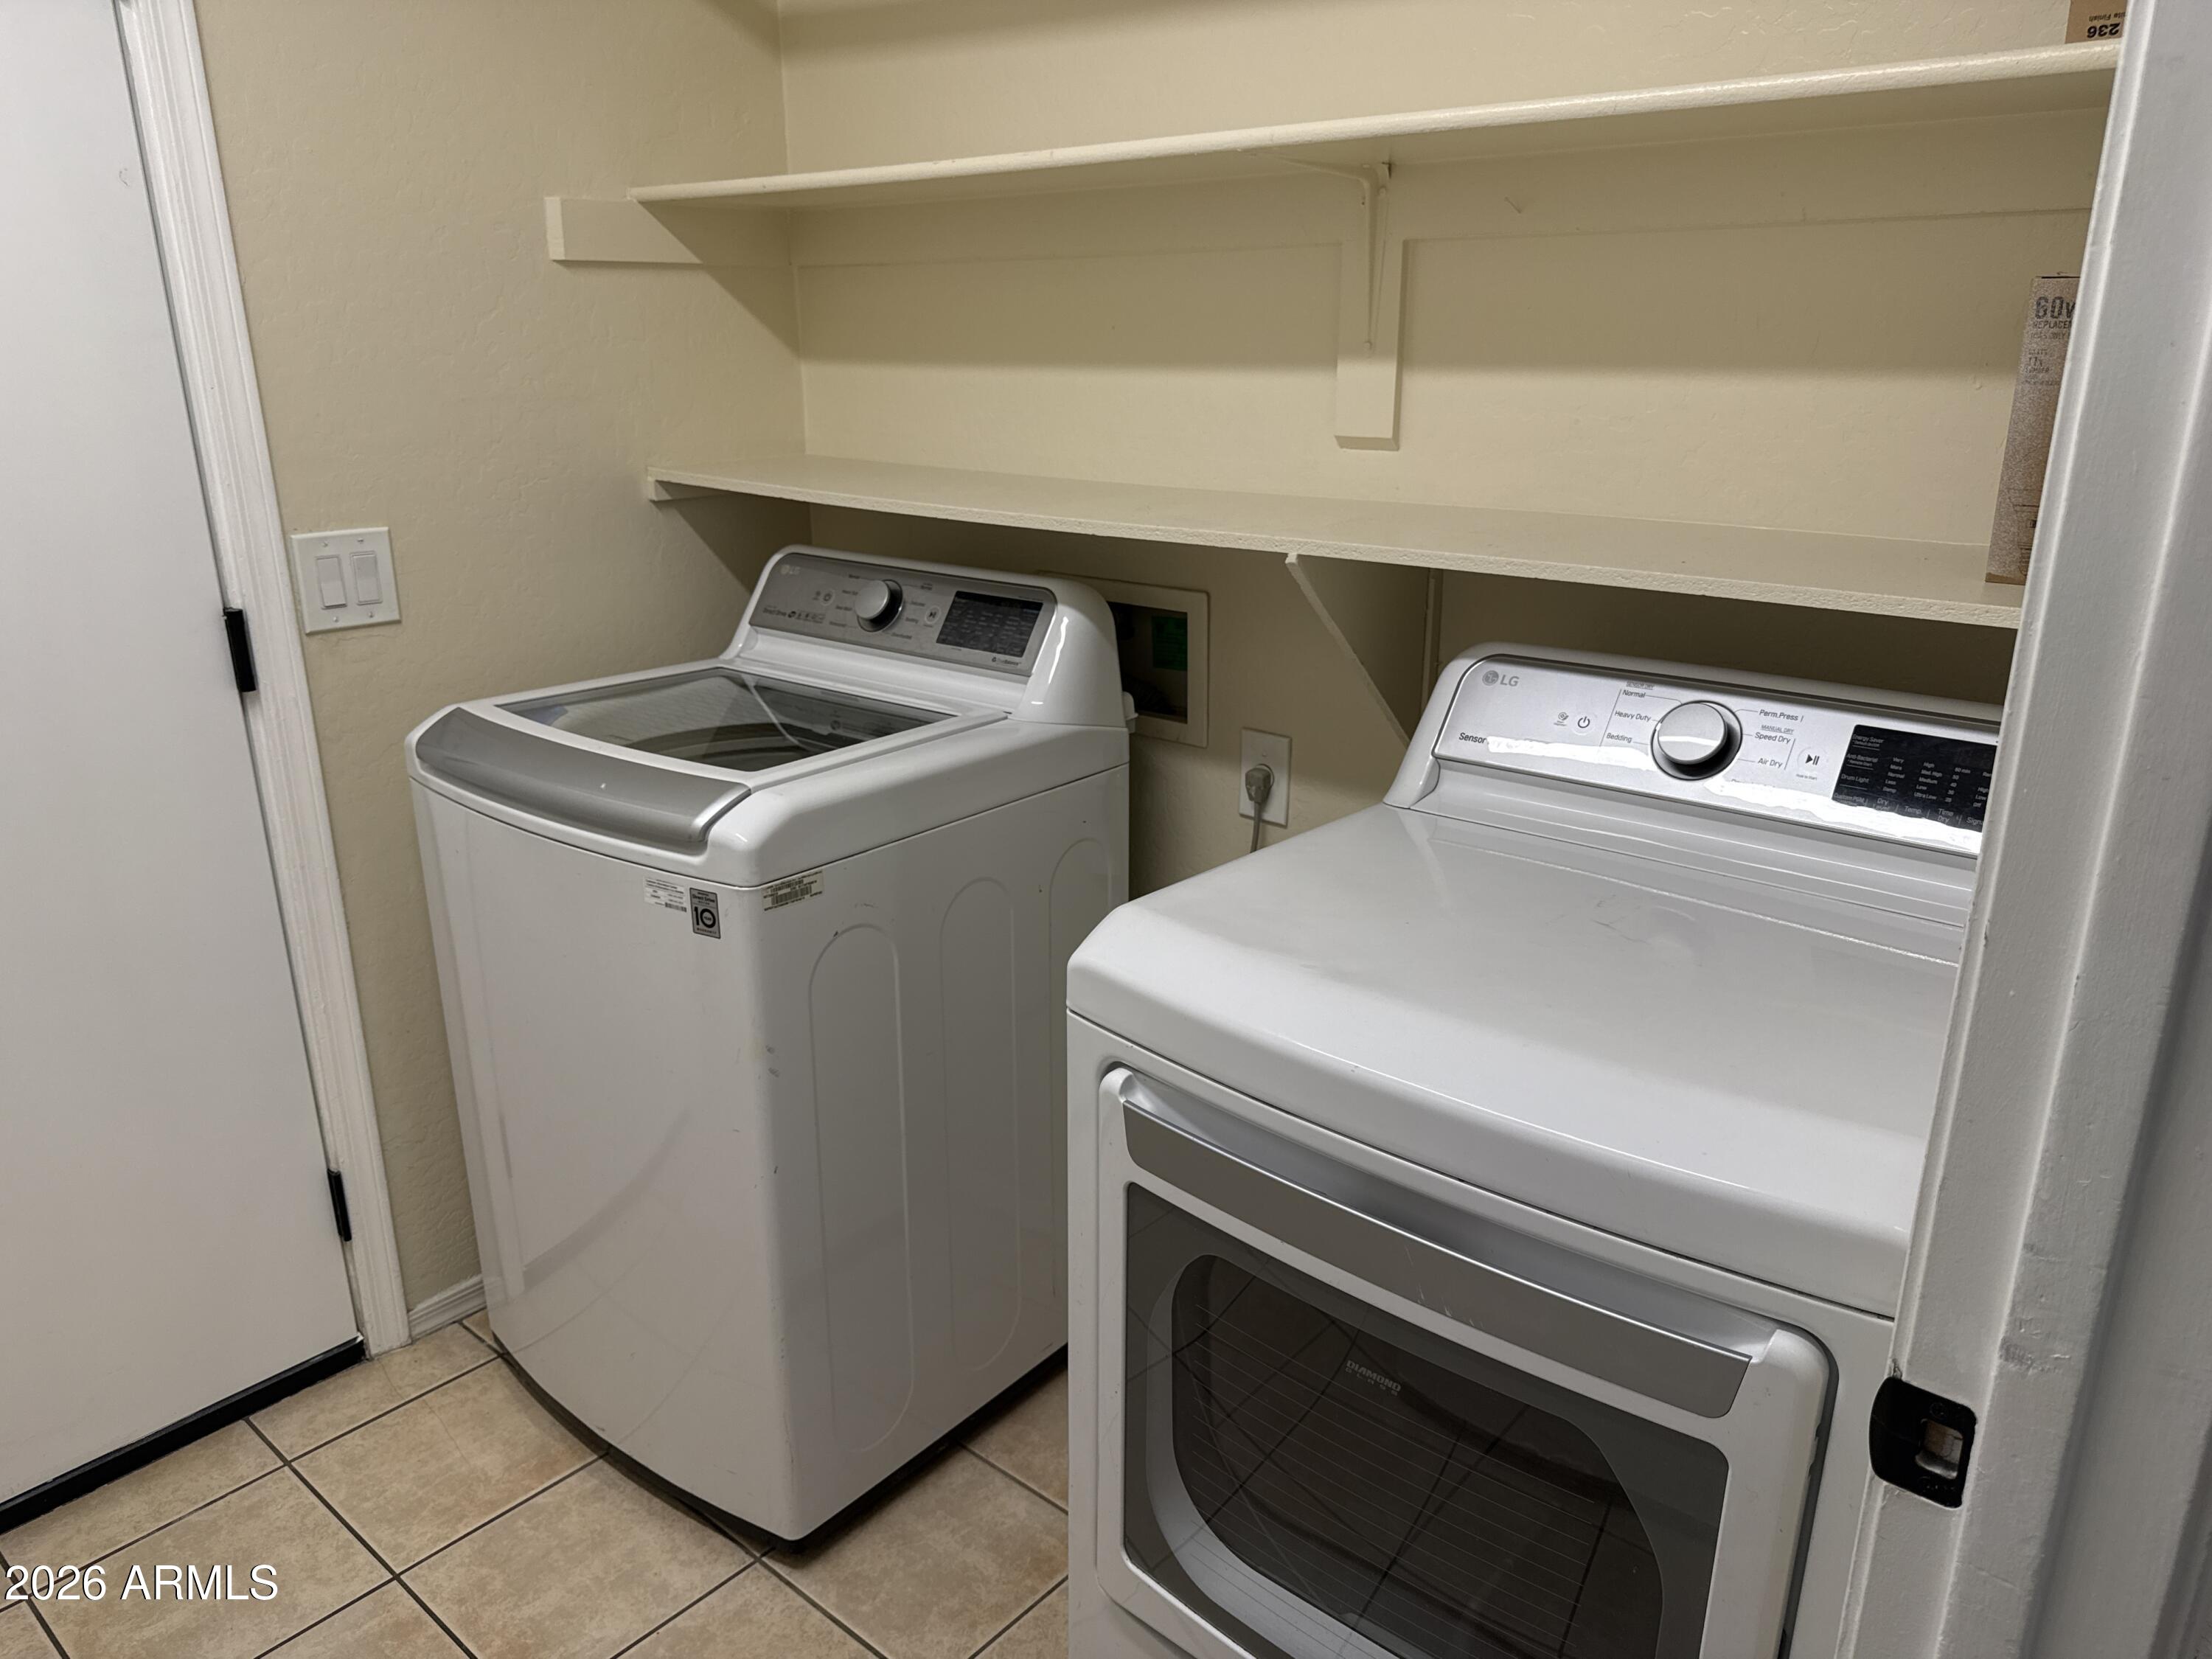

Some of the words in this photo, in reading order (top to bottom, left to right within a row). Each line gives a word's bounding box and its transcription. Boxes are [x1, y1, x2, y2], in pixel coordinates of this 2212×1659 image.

[2087, 23, 2121, 38] 236
[1500, 674, 1520, 686] LG
[1622, 689, 1646, 698] Normal
[1615, 710, 1635, 720] Heavy
[1635, 713, 1652, 722] Duty
[1459, 732, 1486, 744] Sensor
[1606, 732, 1632, 743] Bedding
[1755, 732, 1777, 742] Speed
[1778, 735, 1791, 744] Dry
[1758, 757, 1770, 765] Air
[1770, 759, 1783, 768] Dry
[1877, 798, 1888, 806] Dry
[695, 906, 716, 928] 10
[1346, 1360, 1401, 1392] DIAMOND
